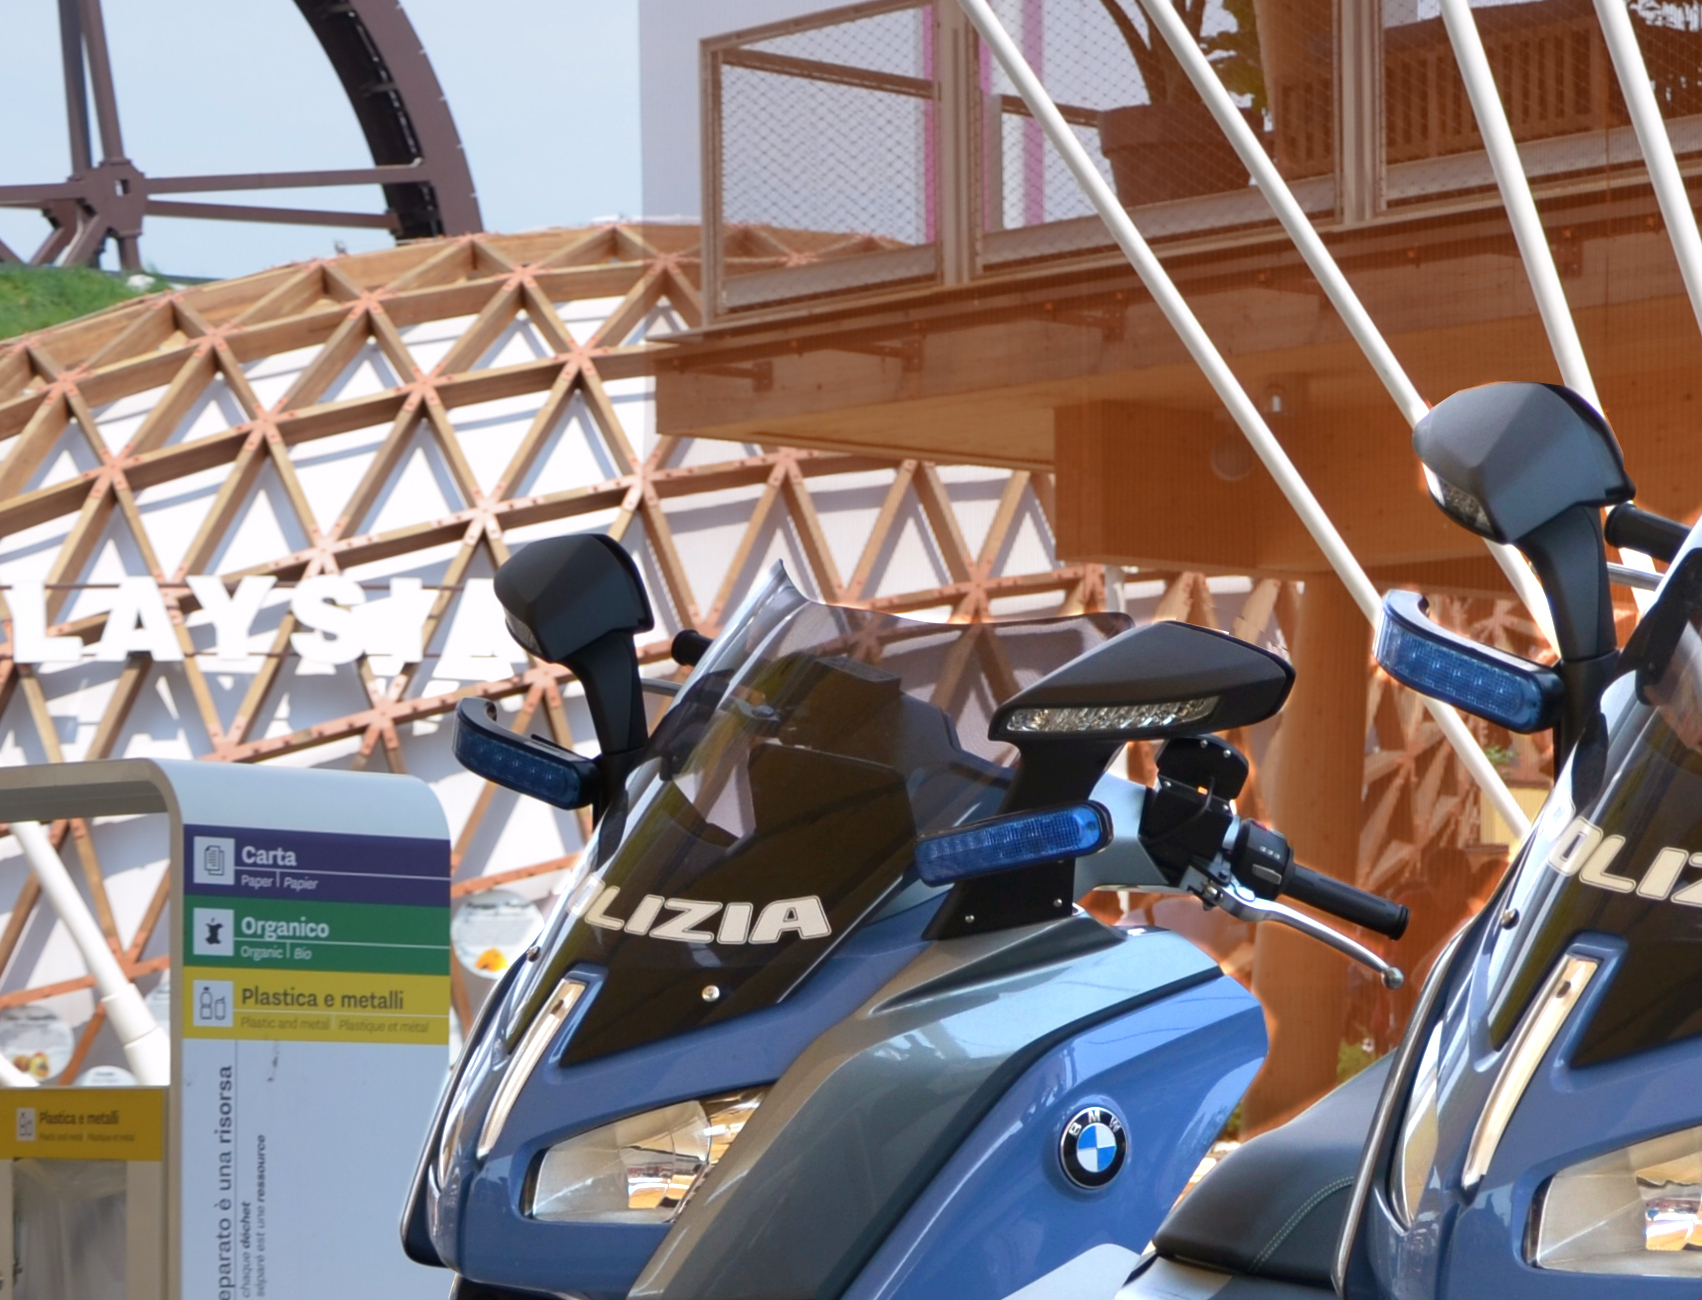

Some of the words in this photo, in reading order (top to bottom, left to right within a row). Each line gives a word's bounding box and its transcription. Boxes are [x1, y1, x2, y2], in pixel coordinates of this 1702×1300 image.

[241, 845, 298, 866] Carta
[241, 874, 274, 889] Paper
[283, 876, 319, 892] Papier
[241, 917, 330, 940] Organico
[240, 945, 284, 961] Organic
[293, 946, 313, 960] Bio
[241, 986, 319, 1007] Plastica
[323, 991, 335, 1007] e
[341, 989, 404, 1010] metalli
[240, 1016, 276, 1029] Plastic
[277, 1017, 298, 1030] and
[300, 1018, 331, 1031] metal
[339, 1019, 386, 1034] Plastique
[213, 1065, 232, 1144] risorsa
[218, 1150, 232, 1191] una
[257, 1134, 266, 1203] ressource
[213, 1198, 232, 1211] è
[239, 1201, 251, 1249] déchet
[257, 1205, 265, 1228] une
[256, 1232, 265, 1252] est
[239, 1251, 253, 1299] chaque
